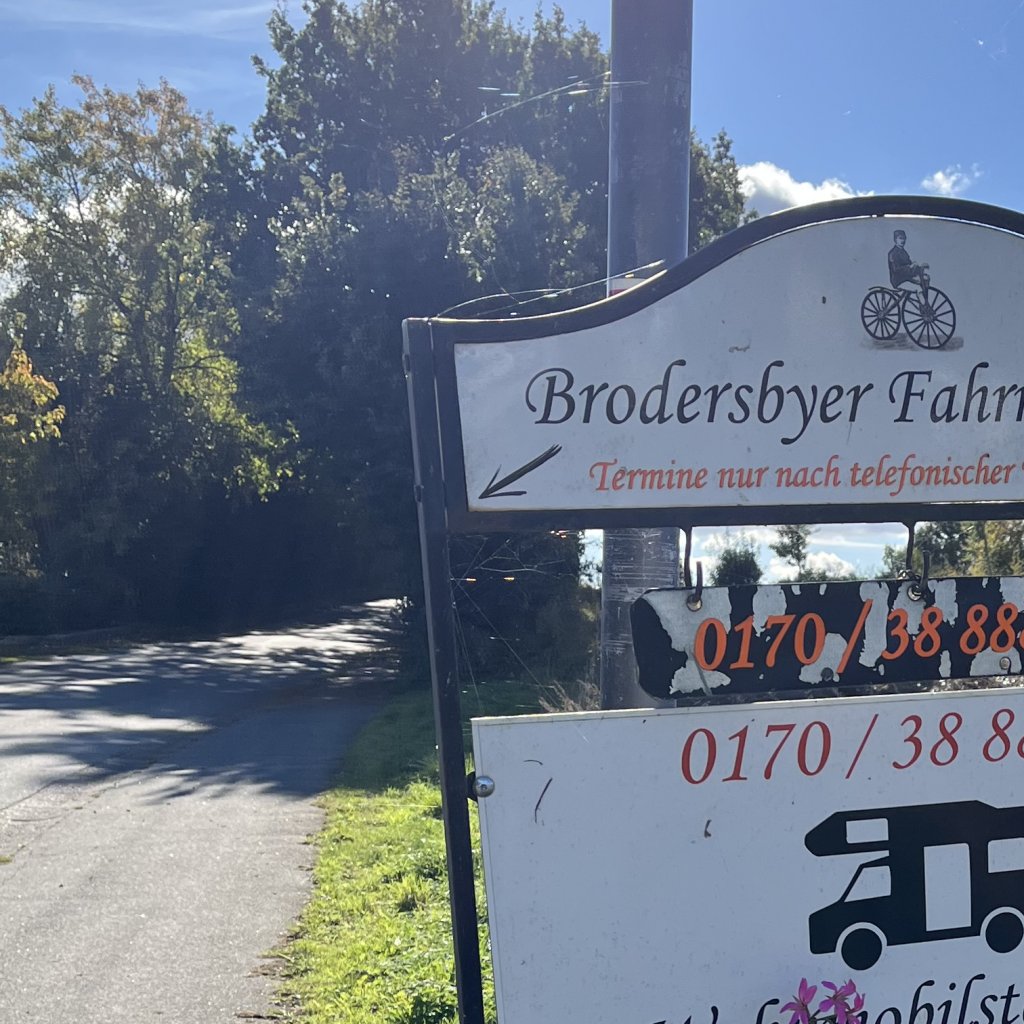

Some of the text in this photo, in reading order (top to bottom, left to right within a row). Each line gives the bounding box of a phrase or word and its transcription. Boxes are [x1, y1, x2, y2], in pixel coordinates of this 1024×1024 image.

[526, 359, 874, 445] Brodersbyer
[590, 458, 708, 491] Termine
[717, 465, 769, 489] nur
[775, 454, 841, 488] nach
[850, 453, 1016, 497] telefonischer
[695, 612, 827, 671] 0170
[836, 599, 874, 673] /
[881, 605, 943, 660] 38
[680, 720, 832, 785] 0170
[845, 713, 879, 779] /
[892, 711, 963, 770] 38
